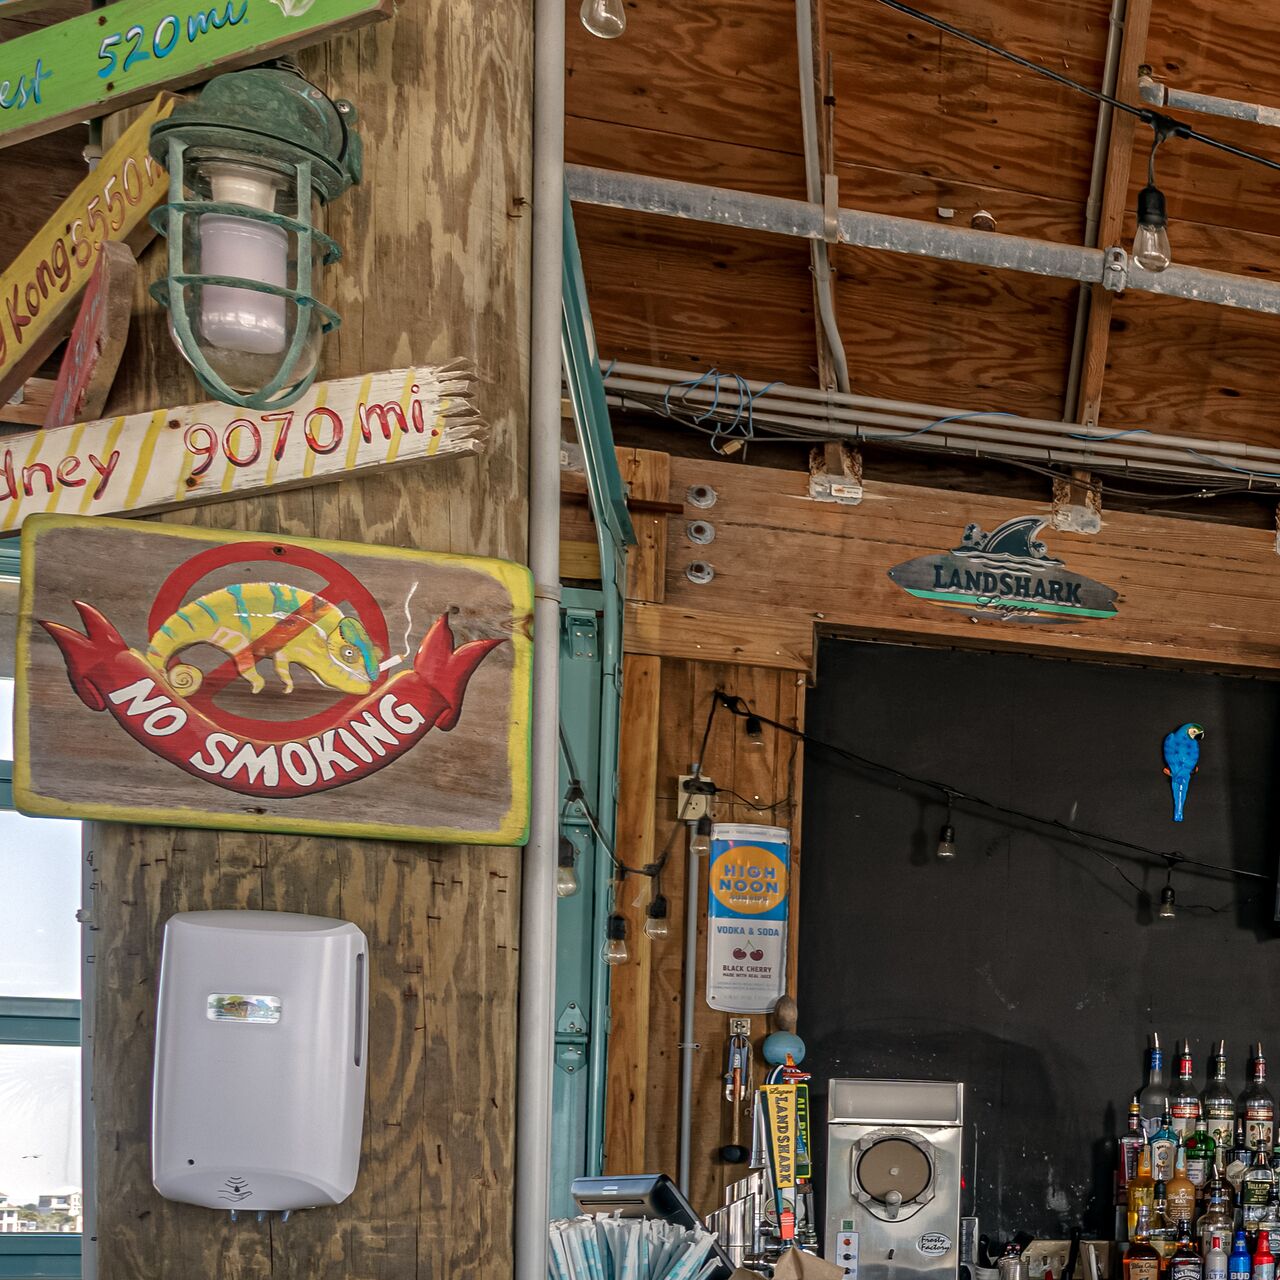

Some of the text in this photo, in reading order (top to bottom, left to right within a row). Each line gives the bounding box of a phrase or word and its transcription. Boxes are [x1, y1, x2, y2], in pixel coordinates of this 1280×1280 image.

[97, 15, 180, 78] 520
[5, 237, 72, 345] Kong
[183, 406, 343, 475] 9070
[359, 384, 439, 444] mi.
[933, 565, 1082, 604] LANDSHARK
[976, 595, 1040, 618] Lager
[109, 677, 426, 788] NO SMOKING
[724, 864, 777, 880] HIGH
[718, 879, 780, 895] NOON
[717, 925, 780, 938] VODKA & SODA
[722, 964, 773, 974] BLACK CHERRY
[775, 1096, 791, 1184] LANDSHARK
[920, 1243, 950, 1252] Factory
[921, 1235, 946, 1245] Frosty
[1230, 1272, 1250, 1280] BUD
